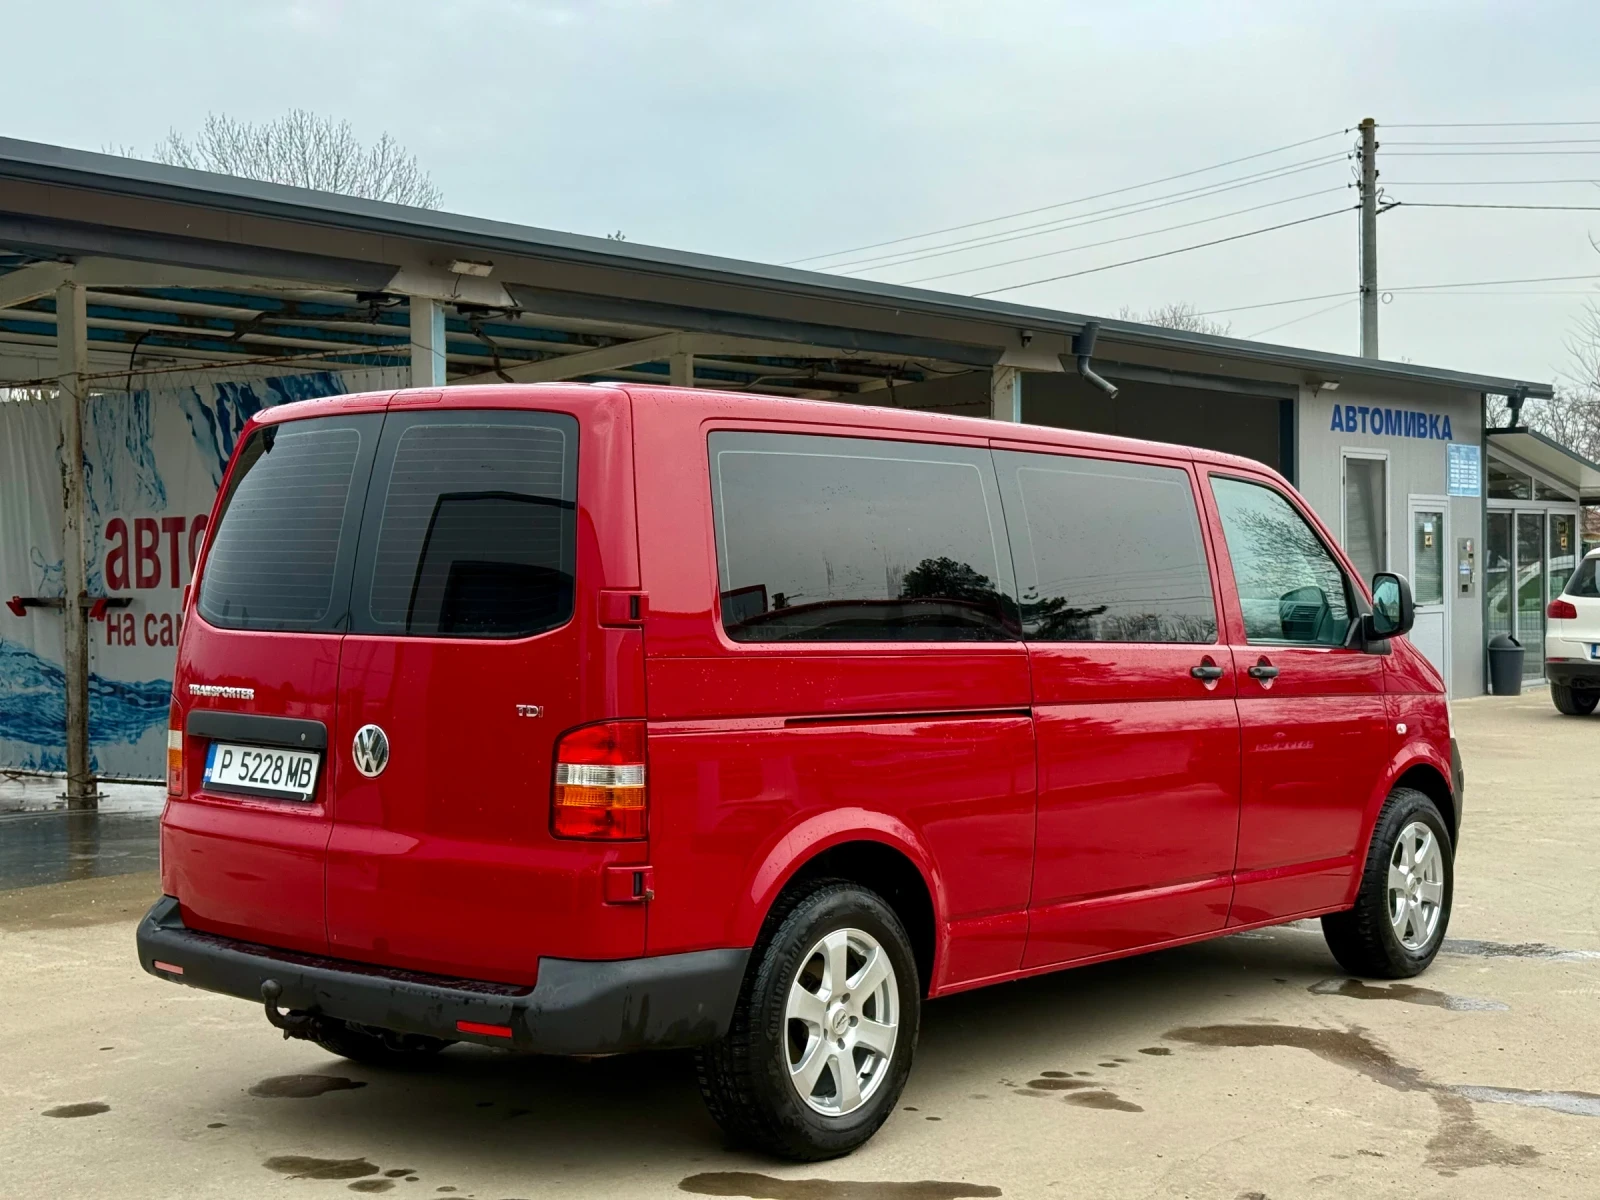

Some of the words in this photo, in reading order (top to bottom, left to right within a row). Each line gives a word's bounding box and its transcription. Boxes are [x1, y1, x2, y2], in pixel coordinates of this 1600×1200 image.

[1330, 404, 1453, 440] АВТОМИВКА
[106, 613, 136, 646] на
[188, 683, 255, 700] TRANSPORTER
[238, 751, 284, 785] 5228
[284, 756, 313, 788] MB
